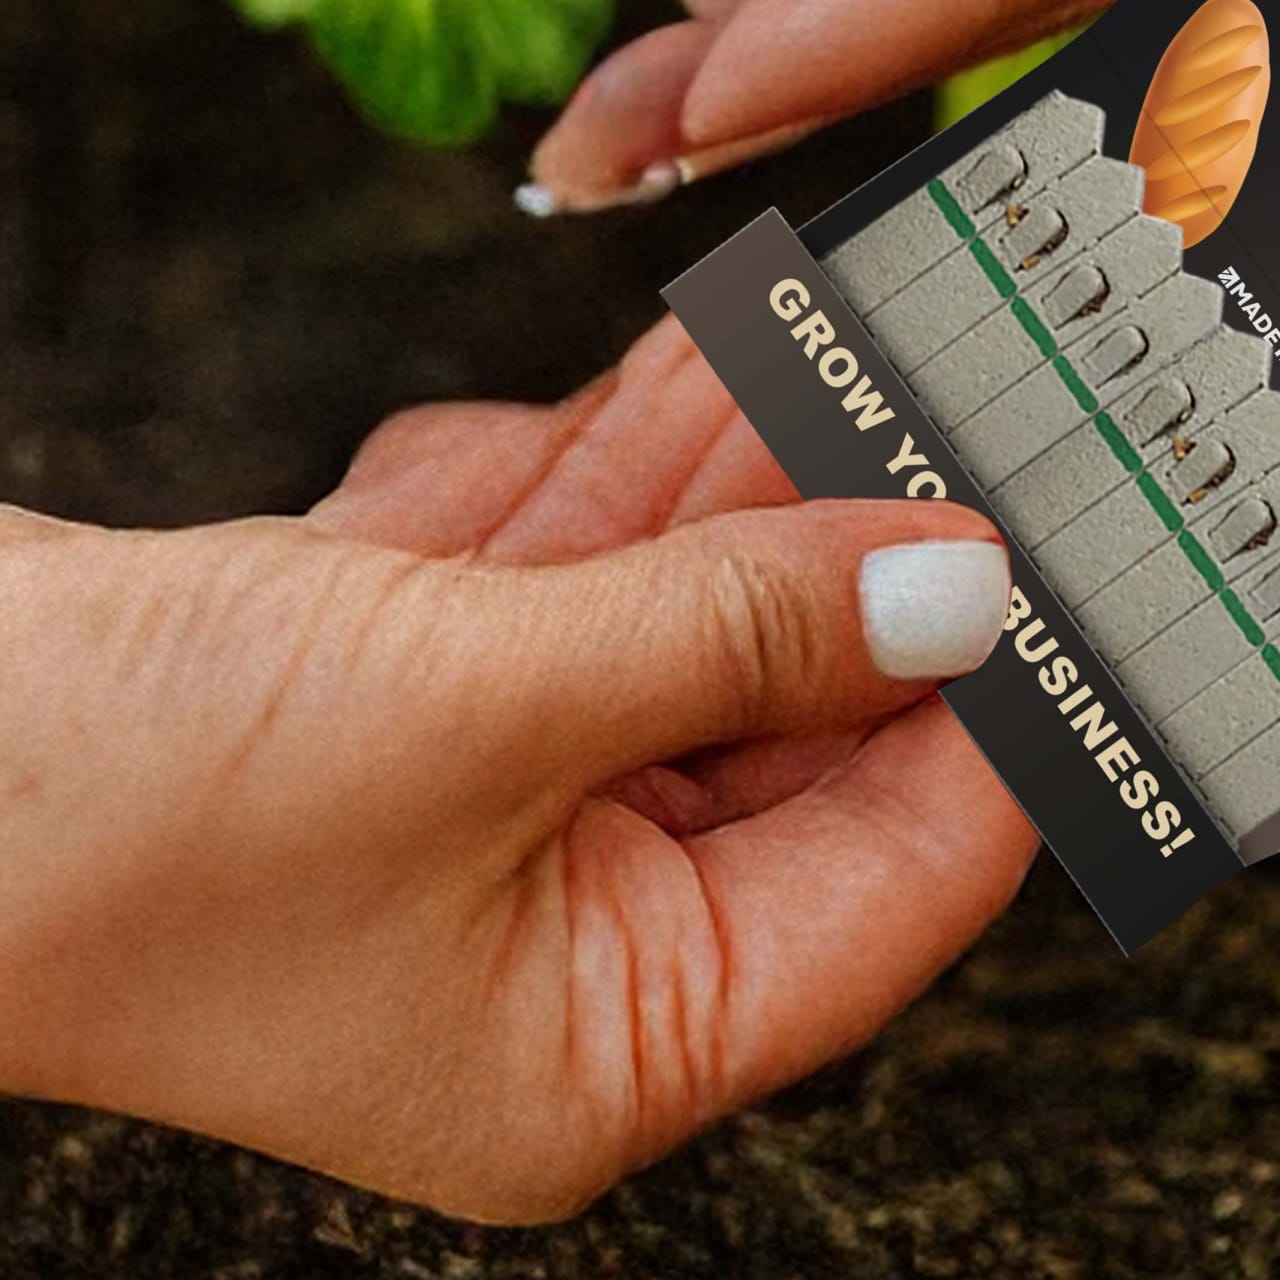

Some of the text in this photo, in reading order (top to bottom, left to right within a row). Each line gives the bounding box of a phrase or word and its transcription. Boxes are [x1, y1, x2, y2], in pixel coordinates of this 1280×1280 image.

[768, 278, 1196, 858] GROW YO BUSINESS!
